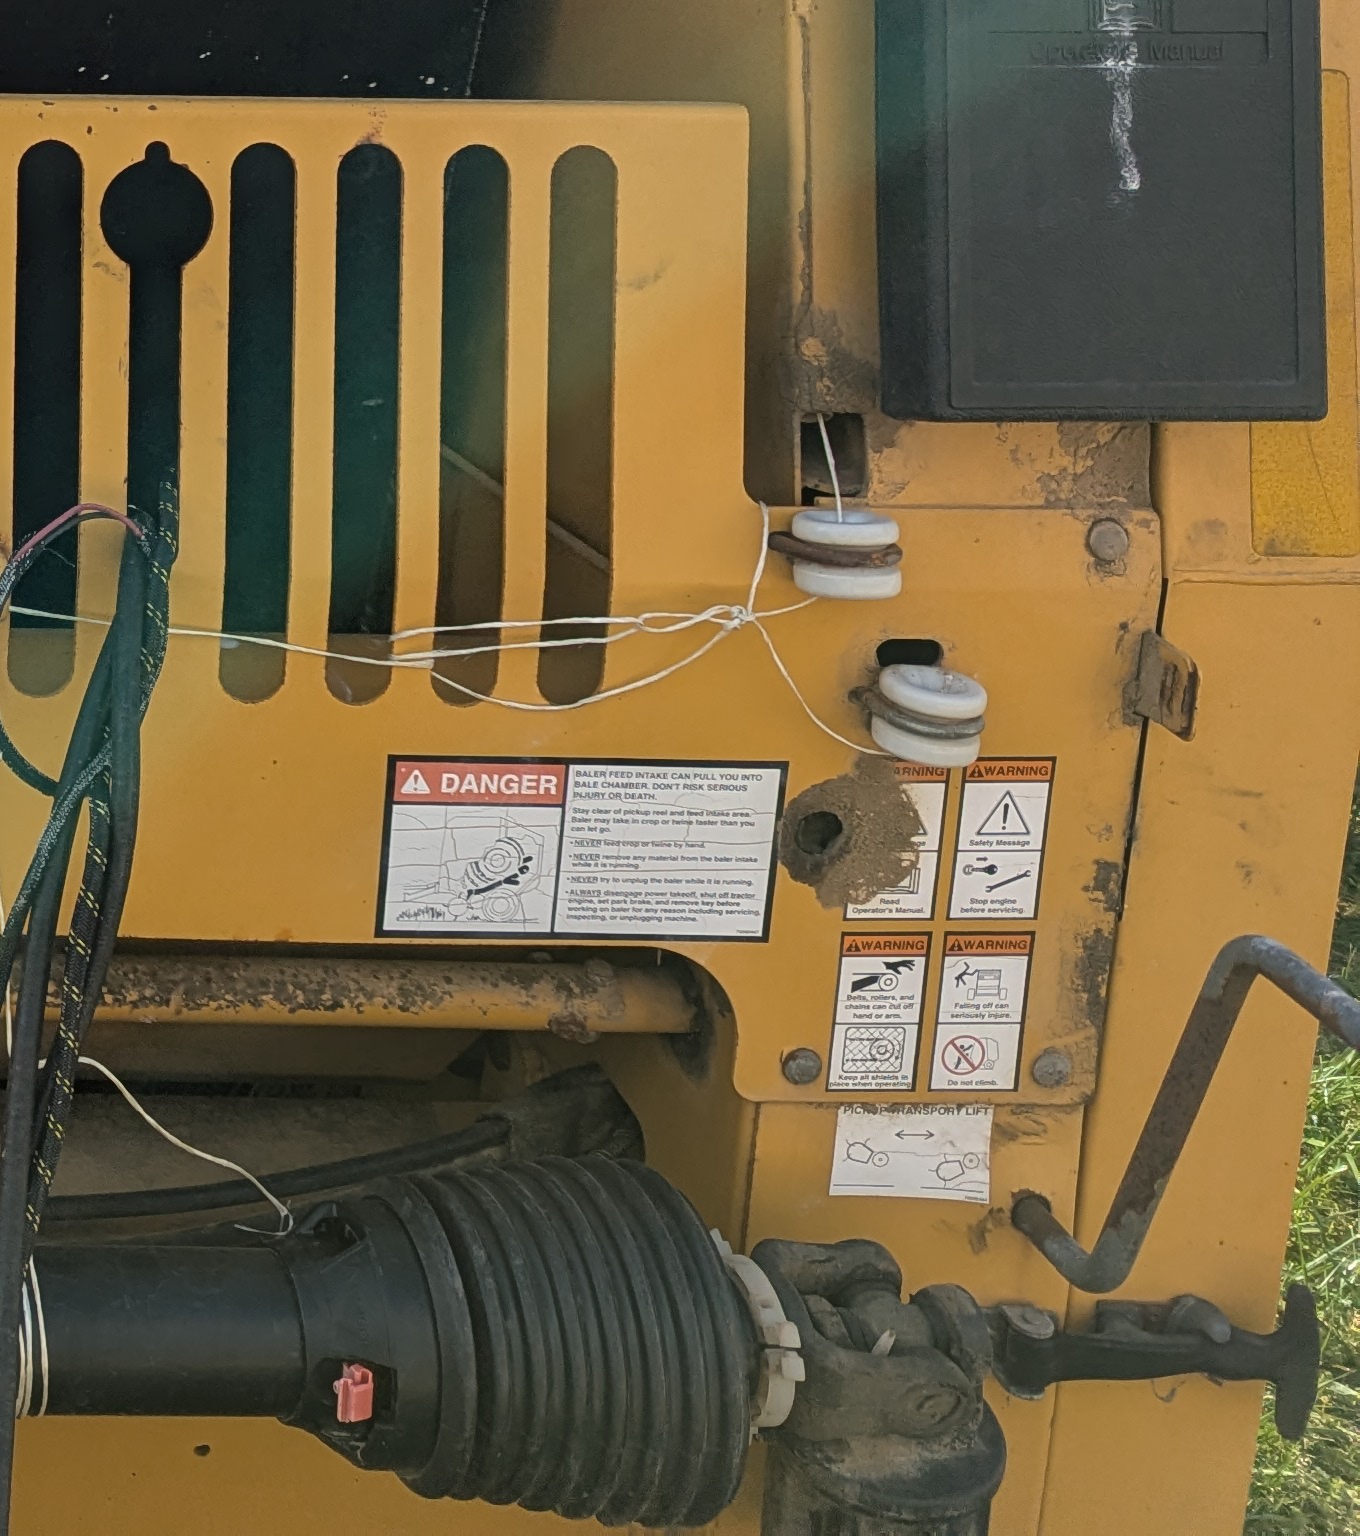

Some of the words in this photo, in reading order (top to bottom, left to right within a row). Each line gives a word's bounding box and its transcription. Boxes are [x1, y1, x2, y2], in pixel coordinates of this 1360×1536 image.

[575, 770, 606, 778] BALER
[693, 772, 716, 780] PULL
[740, 773, 762, 781] INTO
[984, 766, 1048, 776] WARNING
[441, 772, 557, 795] DANGER
[601, 781, 649, 789] CHAMBER.
[652, 782, 680, 790] DON'T
[707, 783, 747, 791] SERIOUS
[572, 791, 606, 799] INJURY
[623, 792, 657, 800] DEATH.
[572, 807, 590, 815] Stay
[623, 808, 650, 816] pickup
[861, 940, 924, 950] WARNING
[964, 940, 1027, 950] WARNING
[965, 1106, 989, 1115] LIFT
